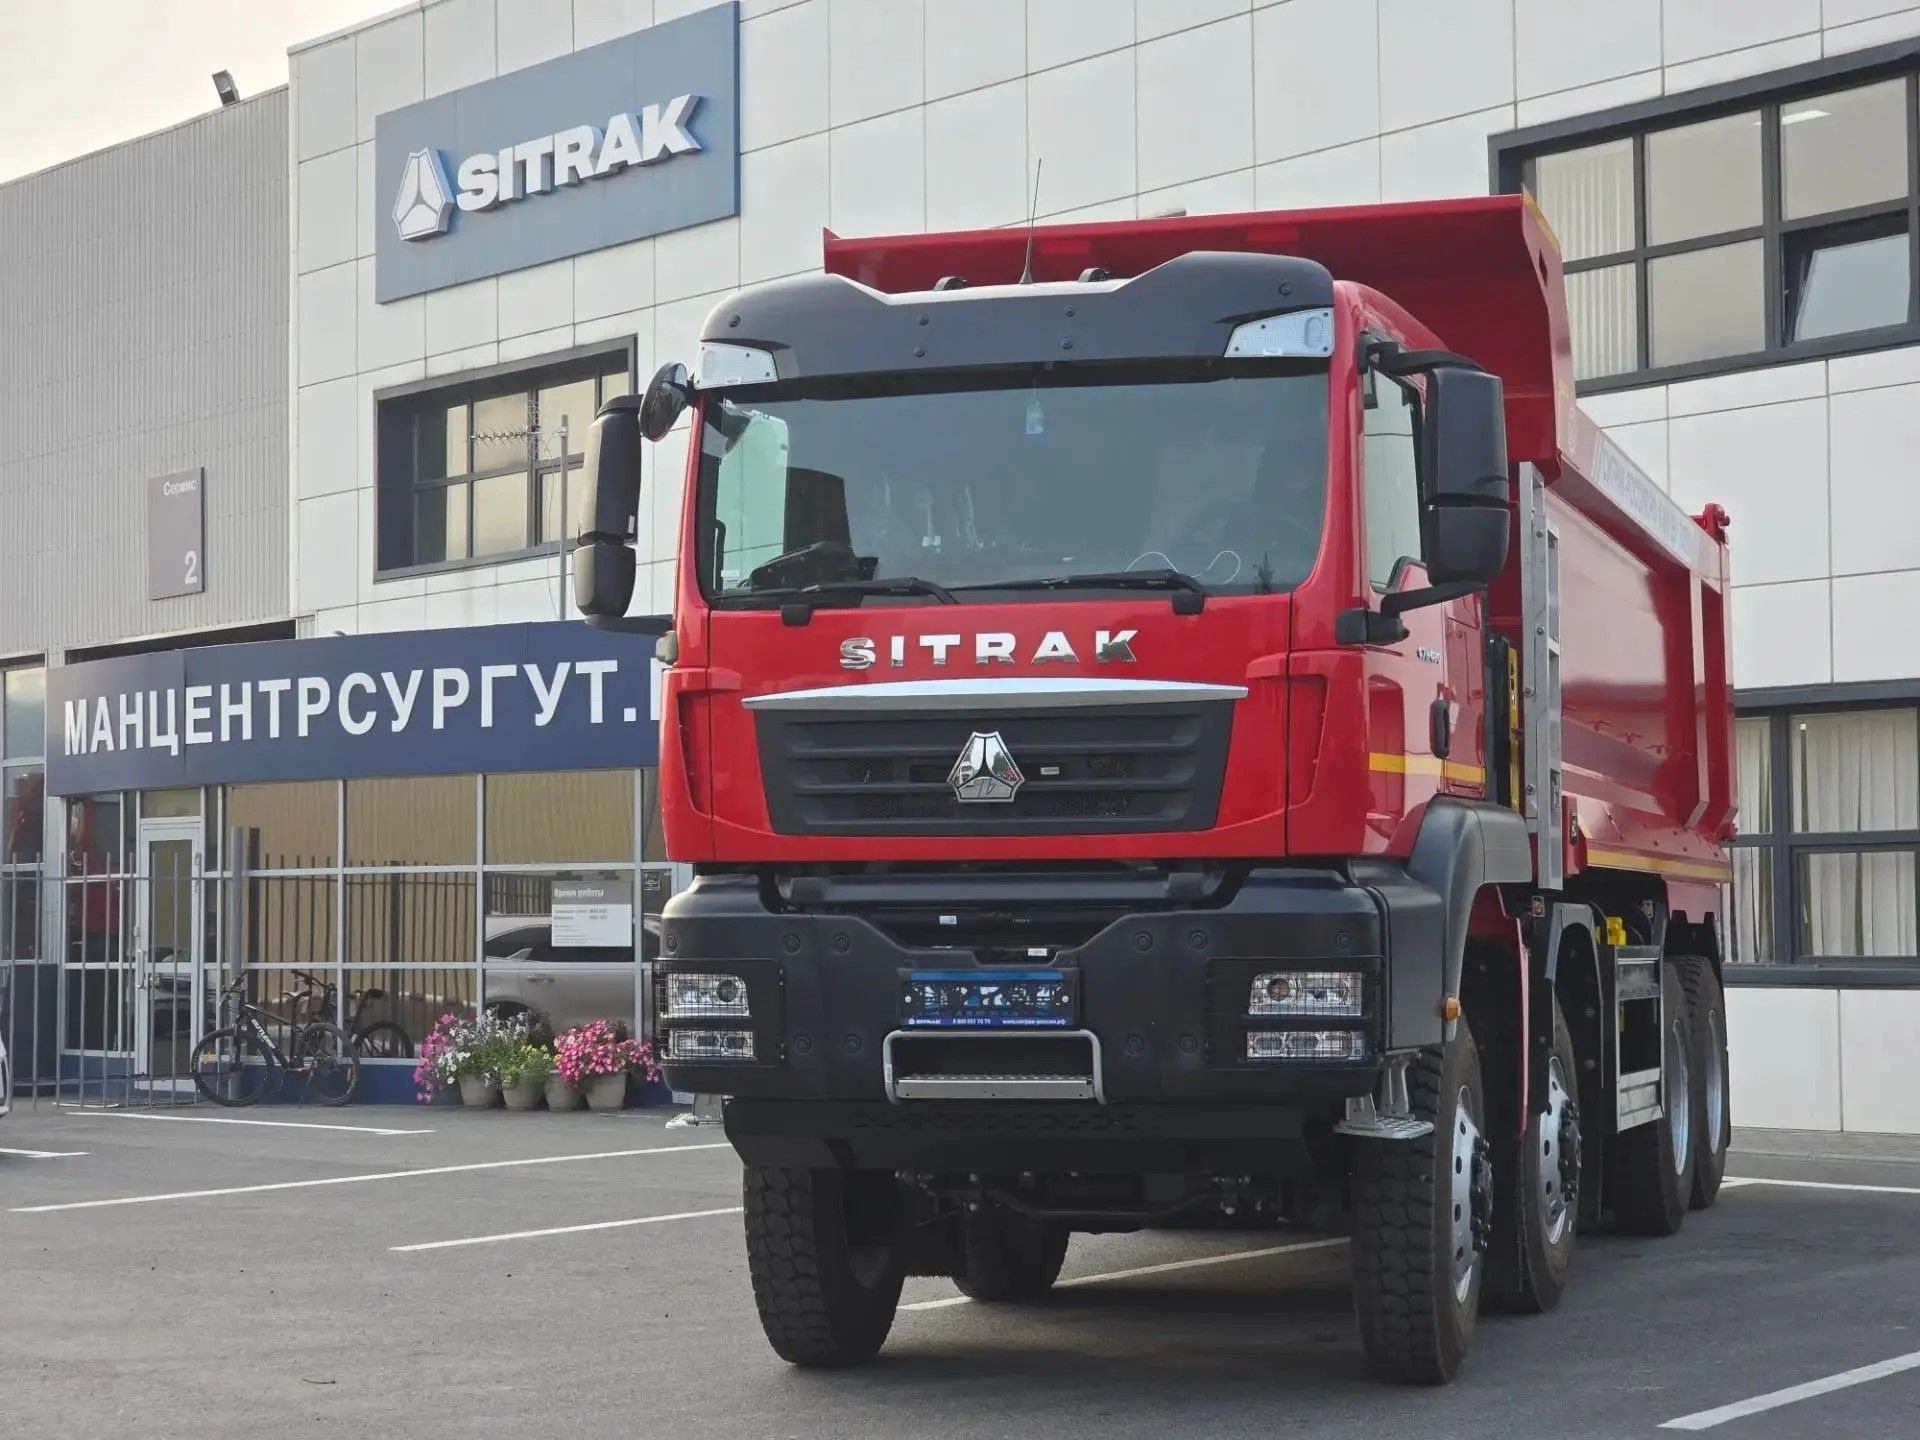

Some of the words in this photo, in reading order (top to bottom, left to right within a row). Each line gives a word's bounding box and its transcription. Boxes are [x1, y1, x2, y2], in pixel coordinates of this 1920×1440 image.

[456, 93, 702, 213] SITRAK
[163, 480, 198, 496] Сервис
[184, 550, 198, 585] 2
[839, 629, 1138, 670] SITRAK
